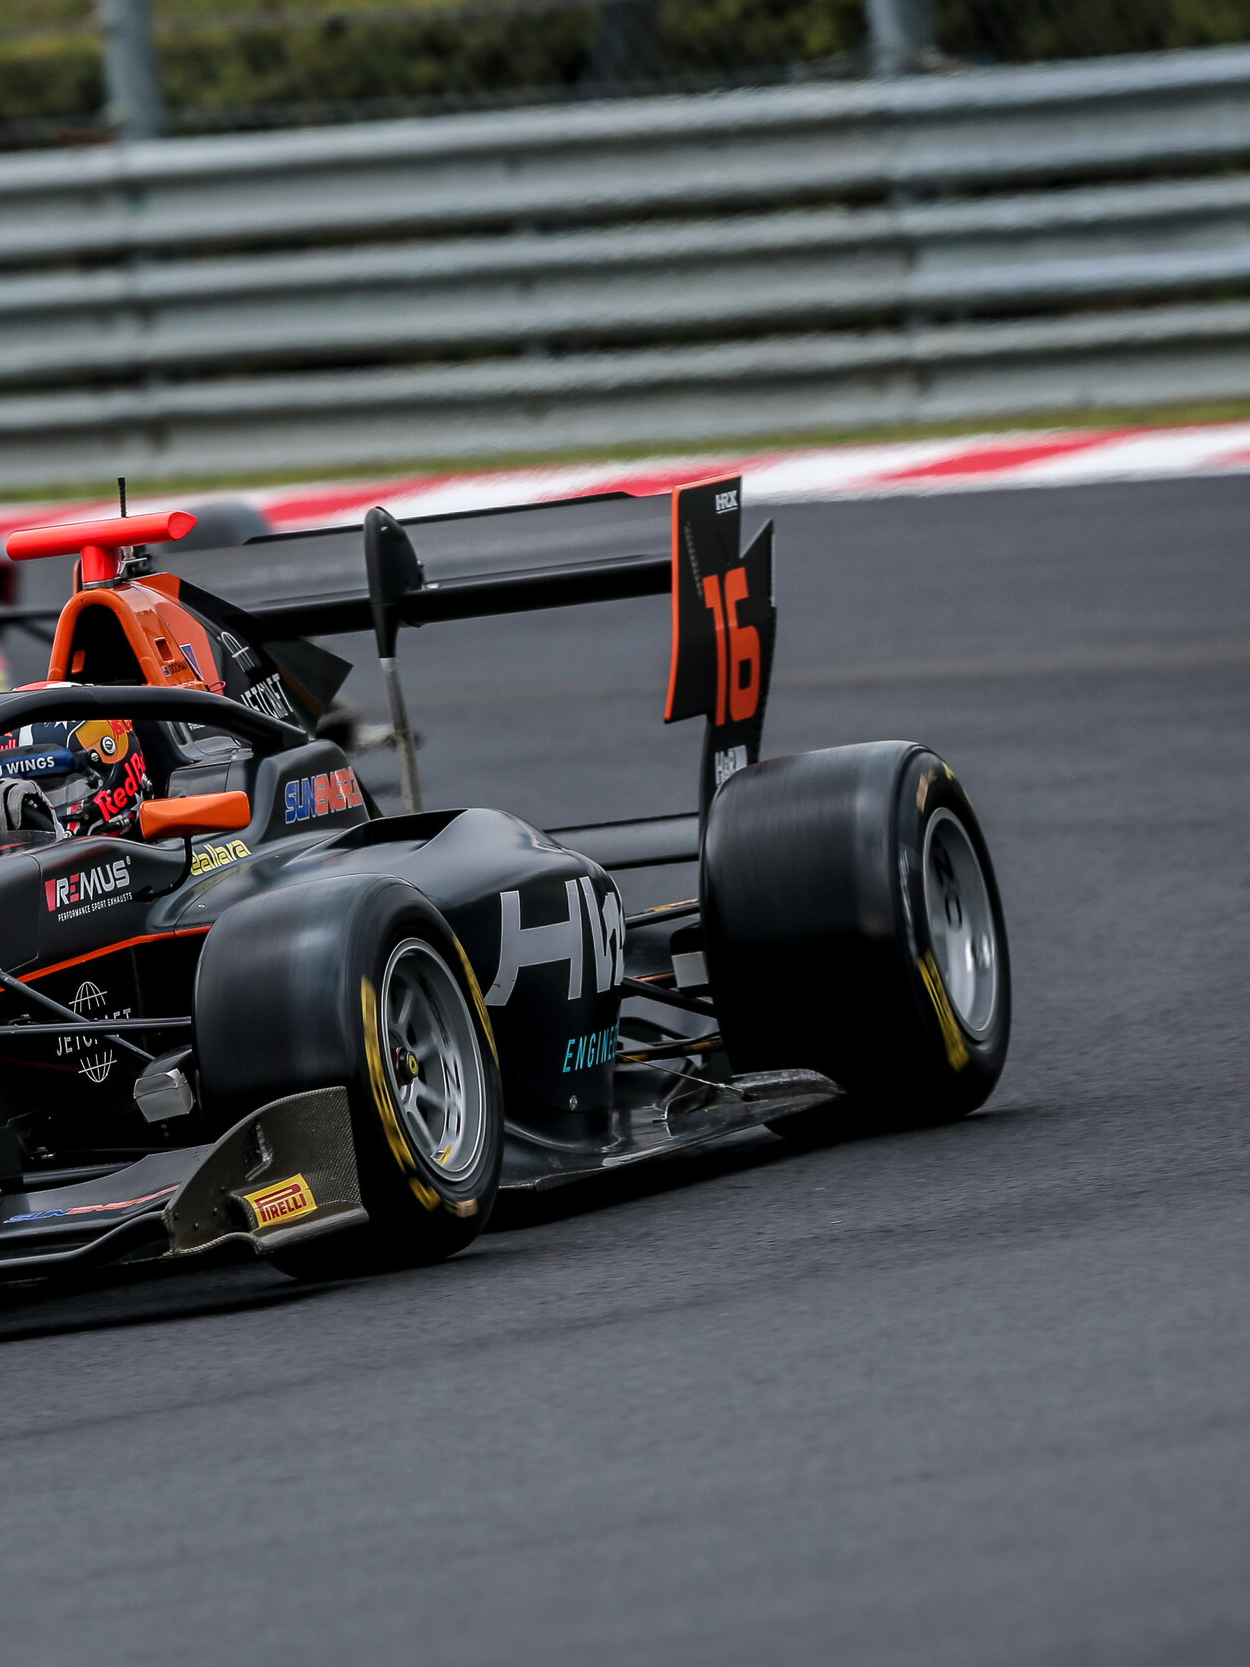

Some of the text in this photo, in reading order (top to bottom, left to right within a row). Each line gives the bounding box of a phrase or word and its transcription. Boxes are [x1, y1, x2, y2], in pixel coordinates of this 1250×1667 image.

[702, 567, 761, 727] 16
[6, 756, 55, 775] WINGS
[57, 891, 133, 922] PERFORMANCE SPORT EXHAUSTS
[483, 876, 625, 1006] HW
[253, 1183, 308, 1223] PIRELLI
